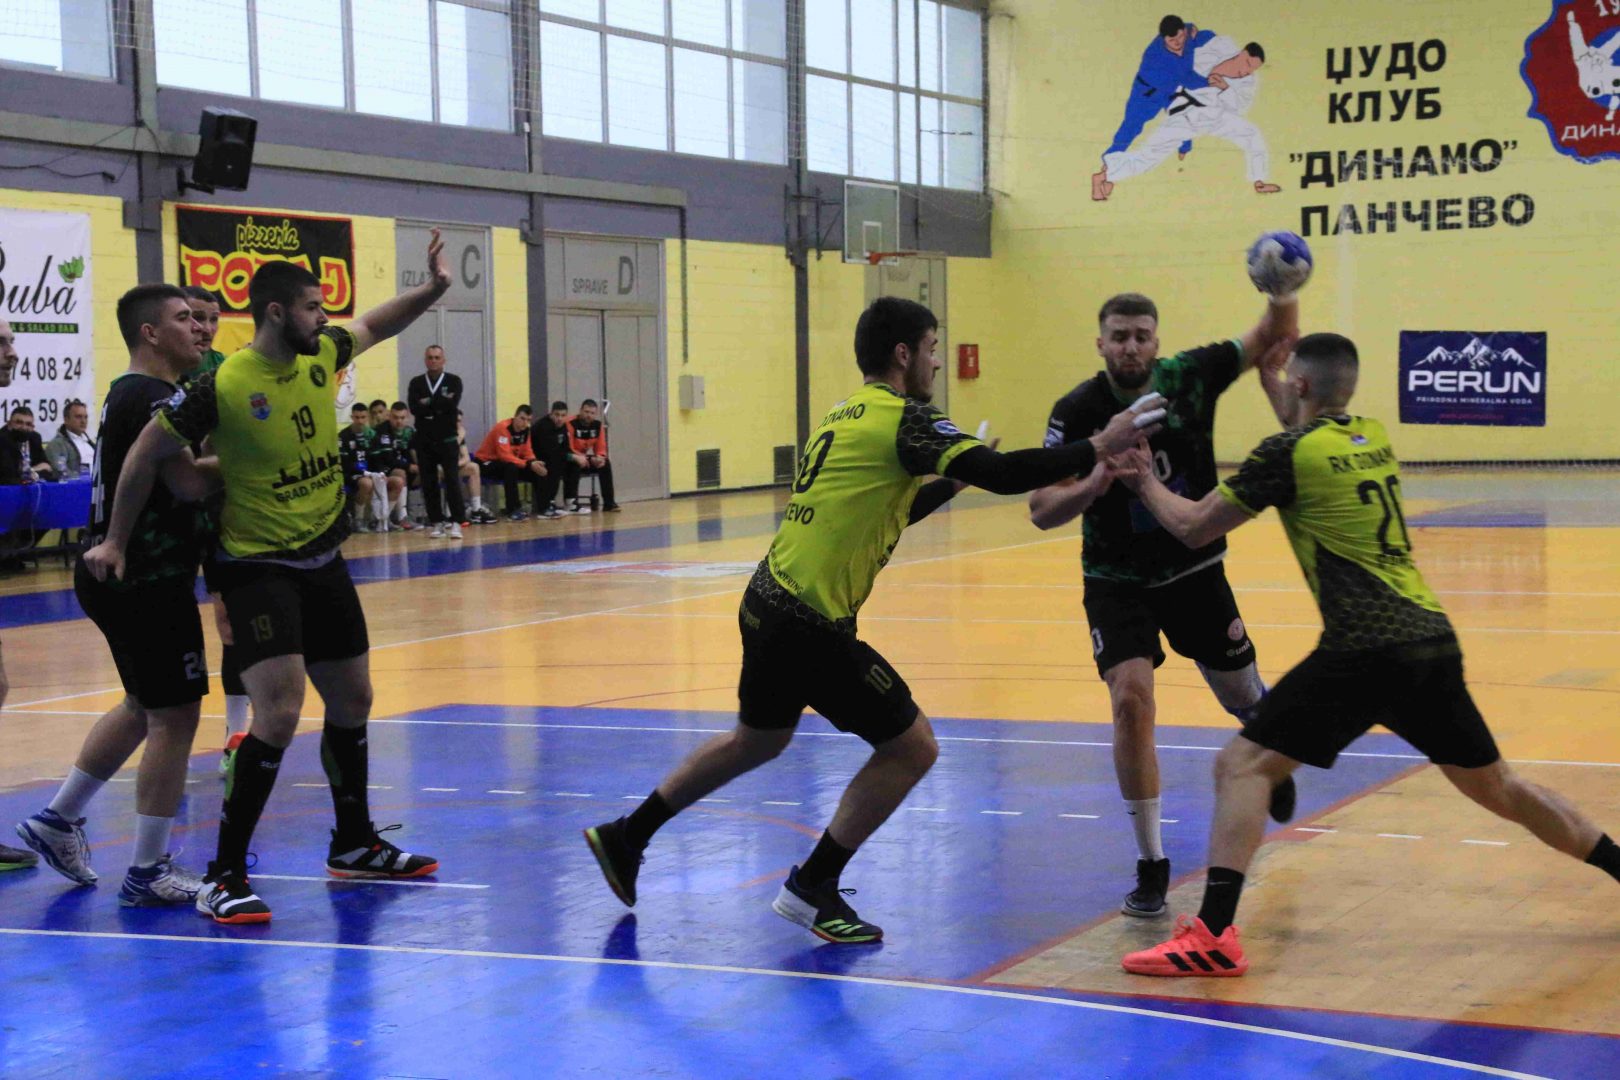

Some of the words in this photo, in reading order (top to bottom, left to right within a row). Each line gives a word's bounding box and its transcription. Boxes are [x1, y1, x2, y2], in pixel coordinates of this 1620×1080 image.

[1326, 39, 1447, 84] ЏУДО
[1328, 86, 1442, 124] КЛУБ
[236, 216, 299, 251] pizzeria
[1301, 193, 1535, 237] ПАНЧЕВО
[0, 241, 77, 315] uba
[181, 244, 352, 311] POJ
[461, 244, 480, 290] C
[618, 256, 634, 295] D
[37, 357, 57, 380] 08
[63, 357, 82, 380] 24
[1408, 370, 1541, 394] PERUN
[39, 399, 58, 422] 59
[291, 405, 316, 443] 19
[250, 615, 273, 643] 19
[865, 664, 892, 695] 10
